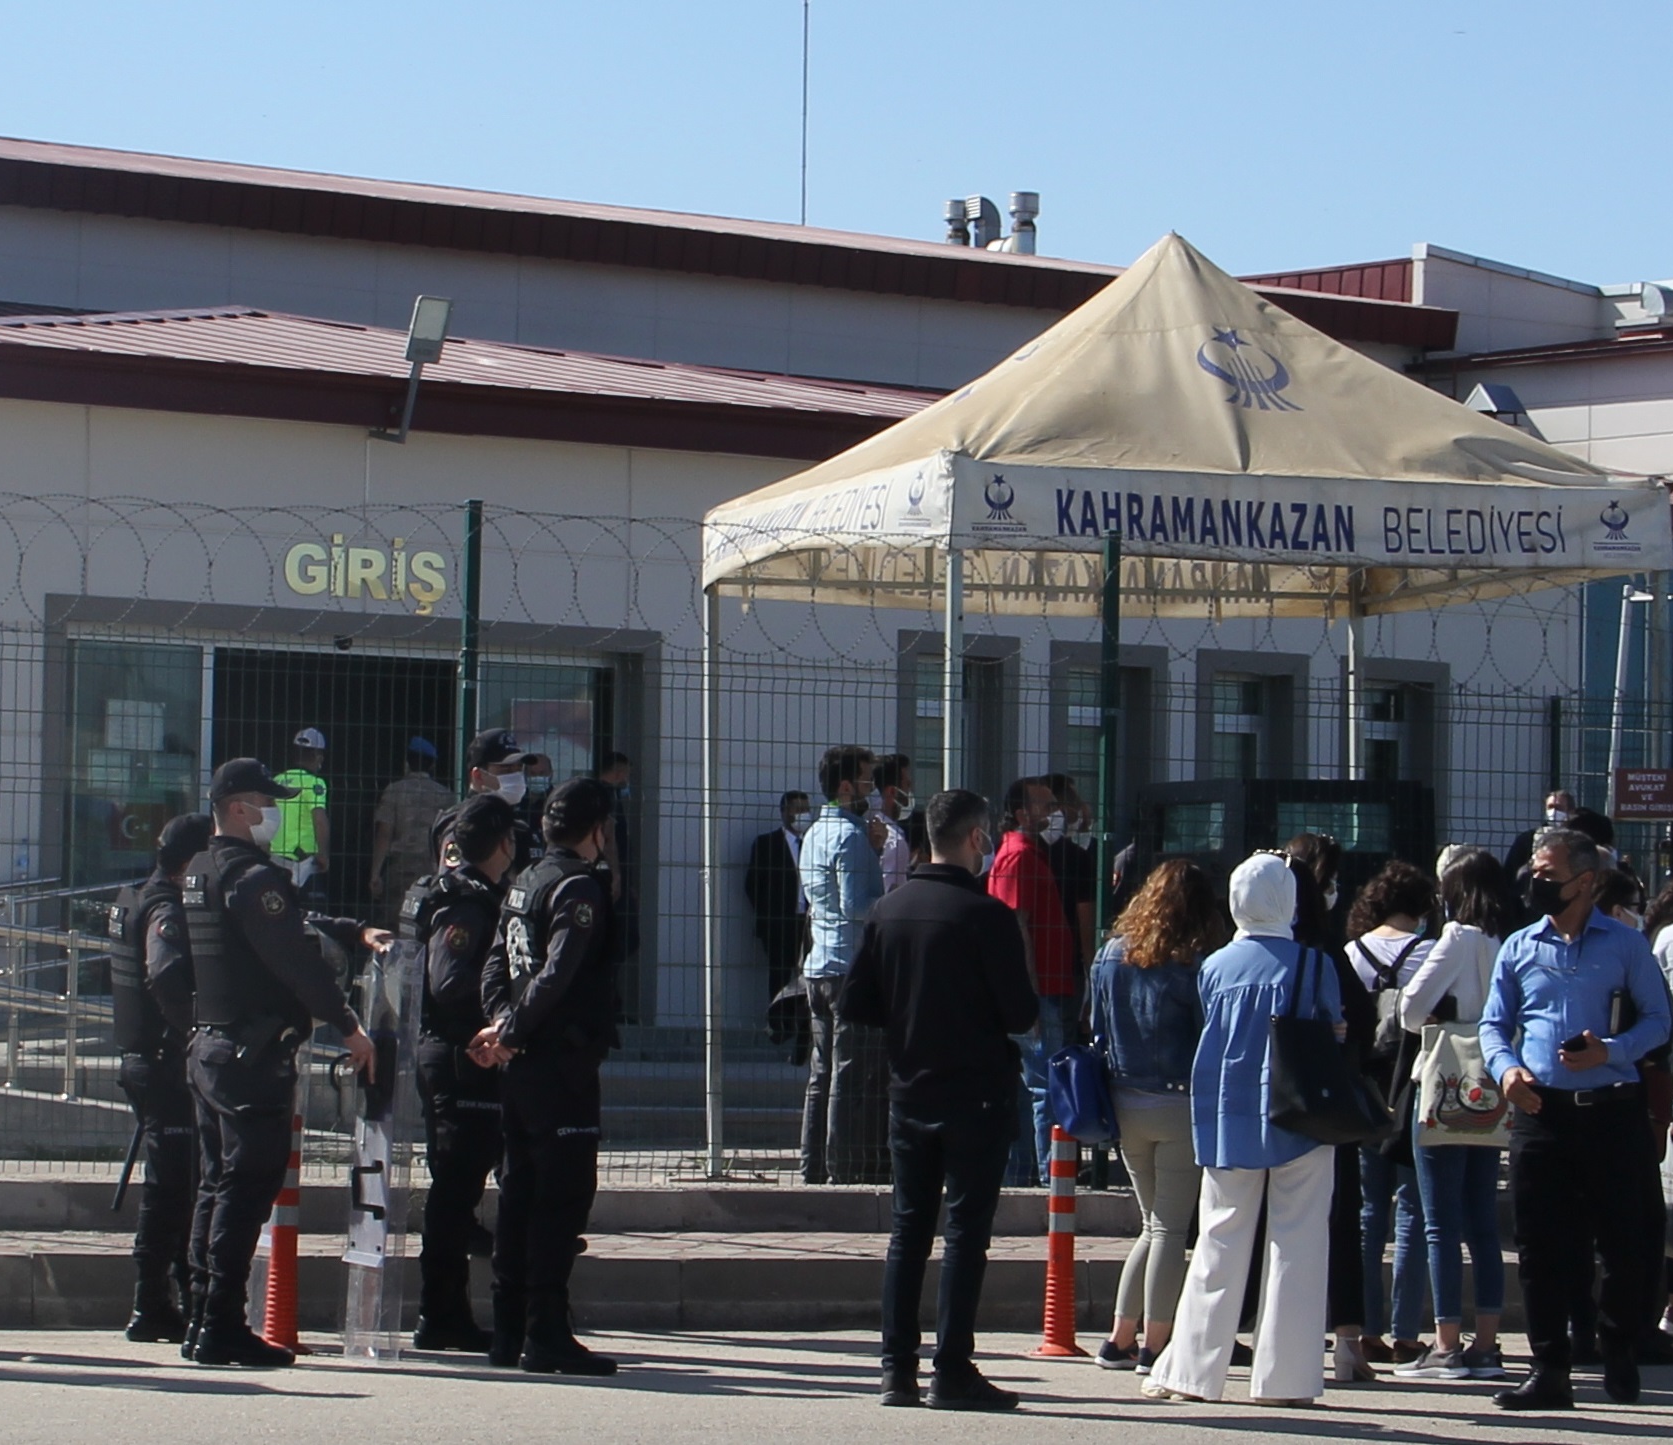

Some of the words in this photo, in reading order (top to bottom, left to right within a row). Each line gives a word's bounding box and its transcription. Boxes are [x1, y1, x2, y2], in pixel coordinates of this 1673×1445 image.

[1056, 488, 1355, 552] KAHRAMANKAZAN
[1383, 505, 1566, 554] BELEDİYESİ
[284, 533, 447, 615] GİRİŞ
